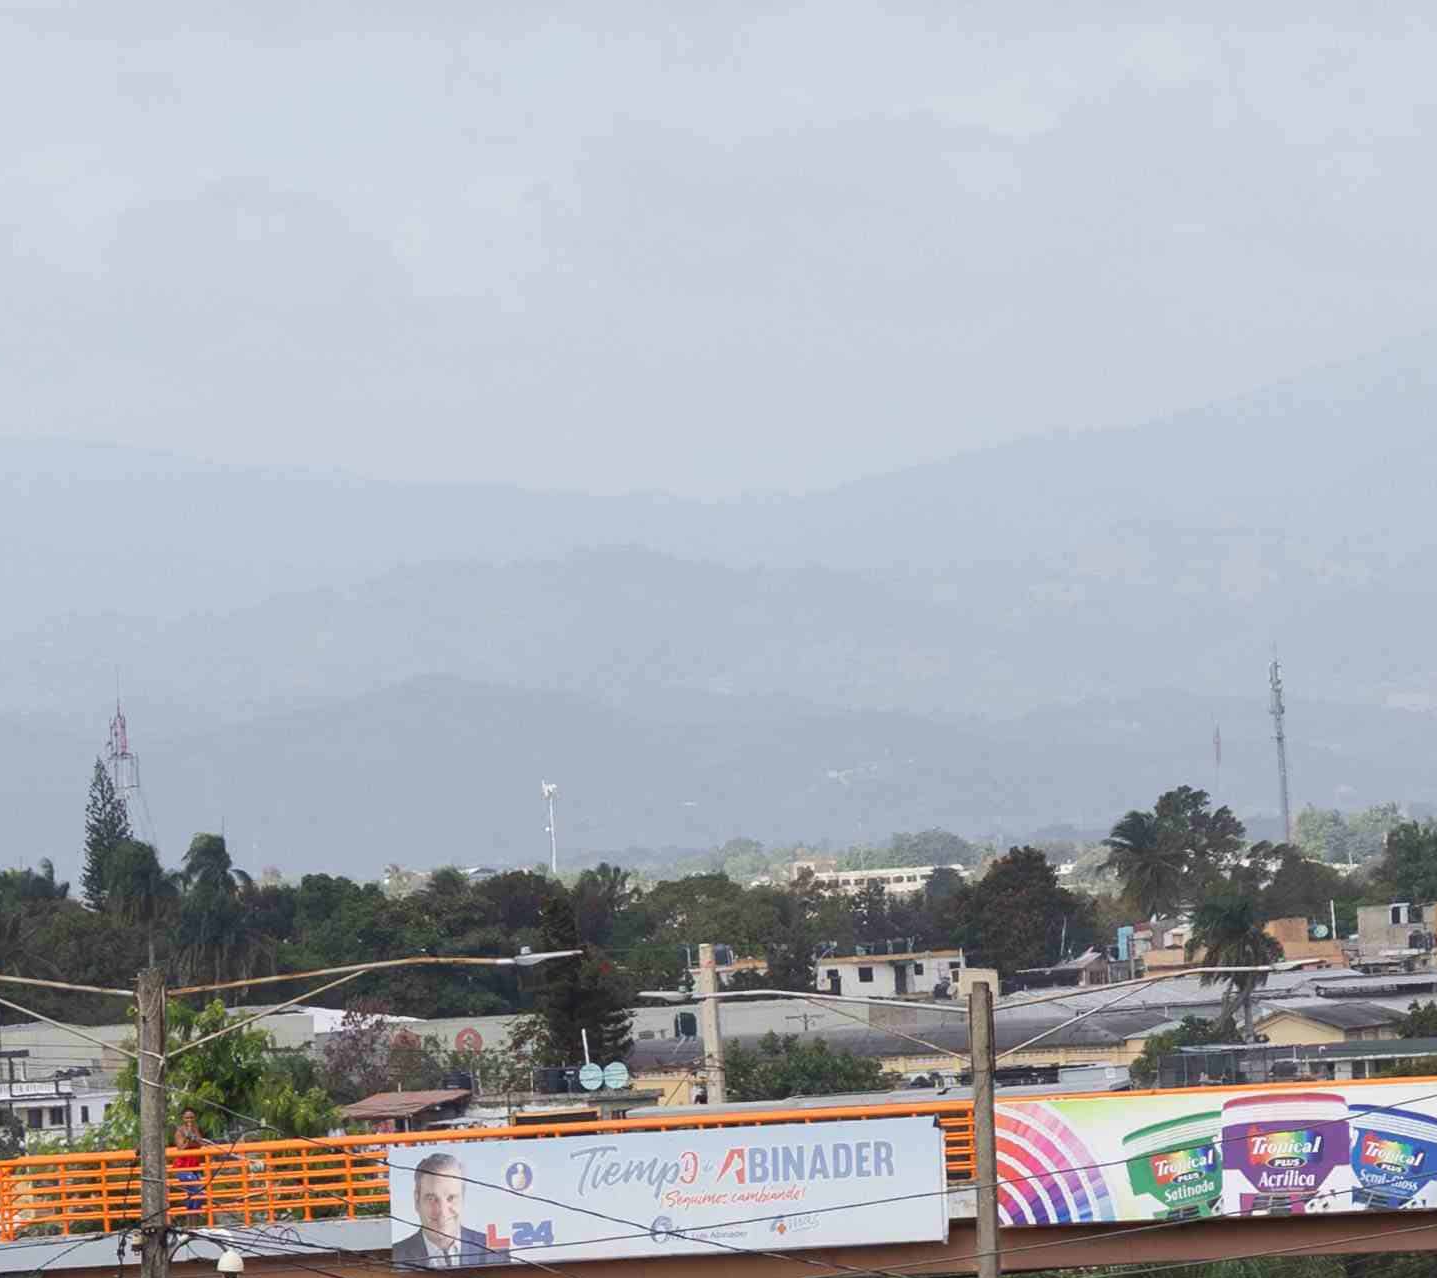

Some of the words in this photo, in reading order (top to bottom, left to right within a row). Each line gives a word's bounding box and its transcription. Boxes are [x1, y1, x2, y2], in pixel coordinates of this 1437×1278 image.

[1252, 1136, 1322, 1154] Tropical
[1363, 1141, 1425, 1168] Tropical
[717, 1142, 895, 1185] ABINADER
[1155, 1149, 1214, 1177] Tropical
[1272, 1158, 1301, 1168] PLUS
[1379, 1163, 1402, 1173] PLUS
[1257, 1168, 1316, 1189] Acrílica
